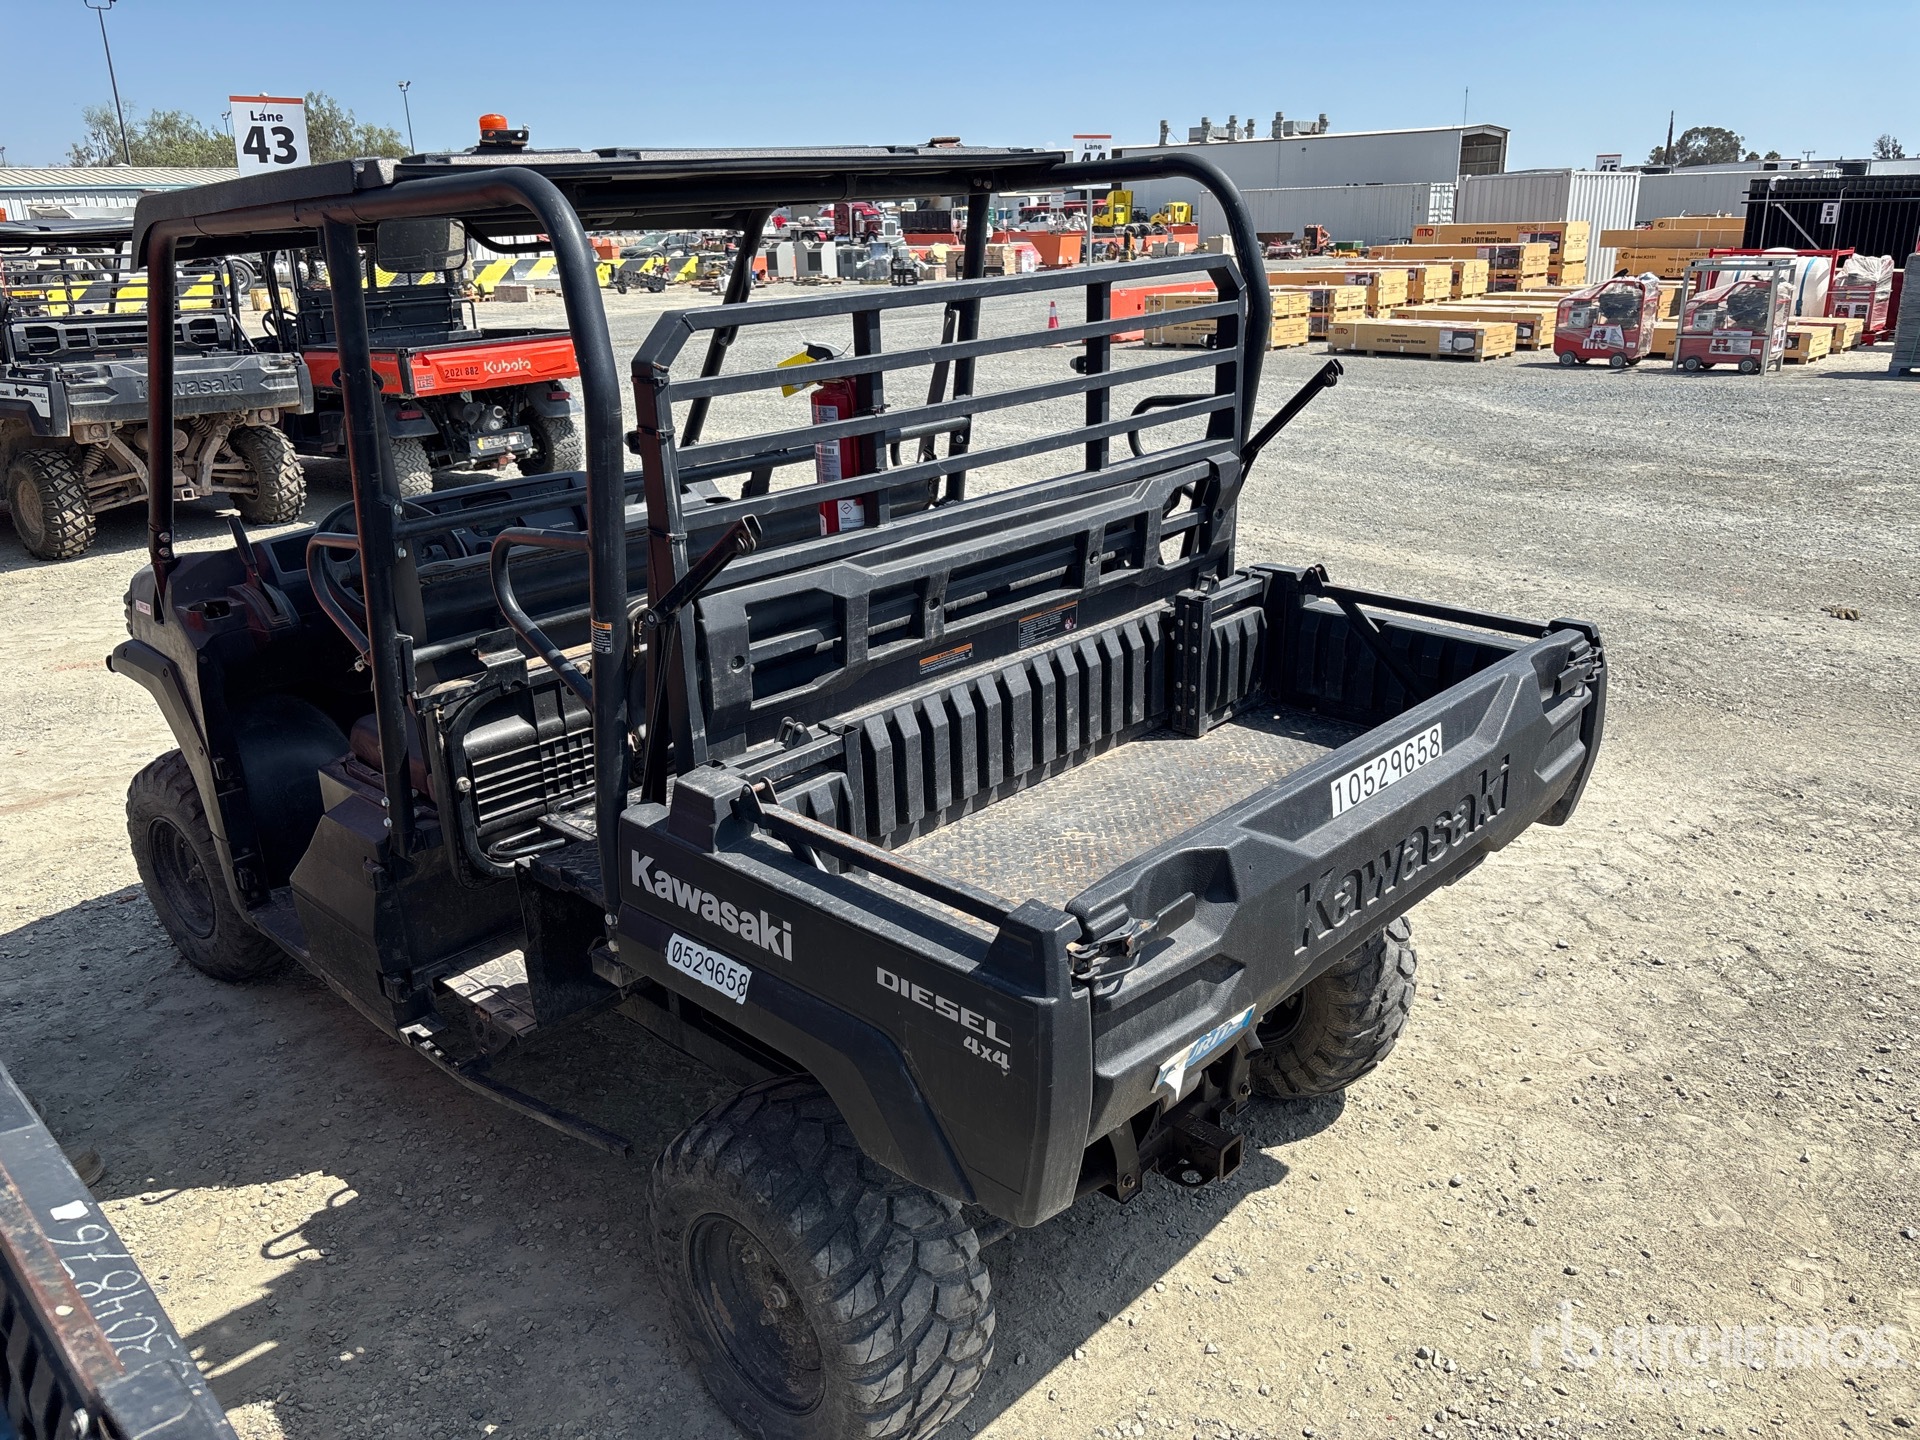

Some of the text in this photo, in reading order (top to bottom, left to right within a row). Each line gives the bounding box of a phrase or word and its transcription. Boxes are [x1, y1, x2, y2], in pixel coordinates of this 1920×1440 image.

[249, 110, 284, 122] Lane
[243, 125, 298, 165] 43
[136, 373, 244, 399] Kwasaki
[483, 358, 532, 374] Kubota
[1334, 728, 1440, 813] 10529658
[1294, 752, 1511, 957] Kawasaki
[631, 849, 793, 962] Kawasaki
[876, 966, 1011, 1048] DIESEL
[963, 1035, 1011, 1071] 4x4
